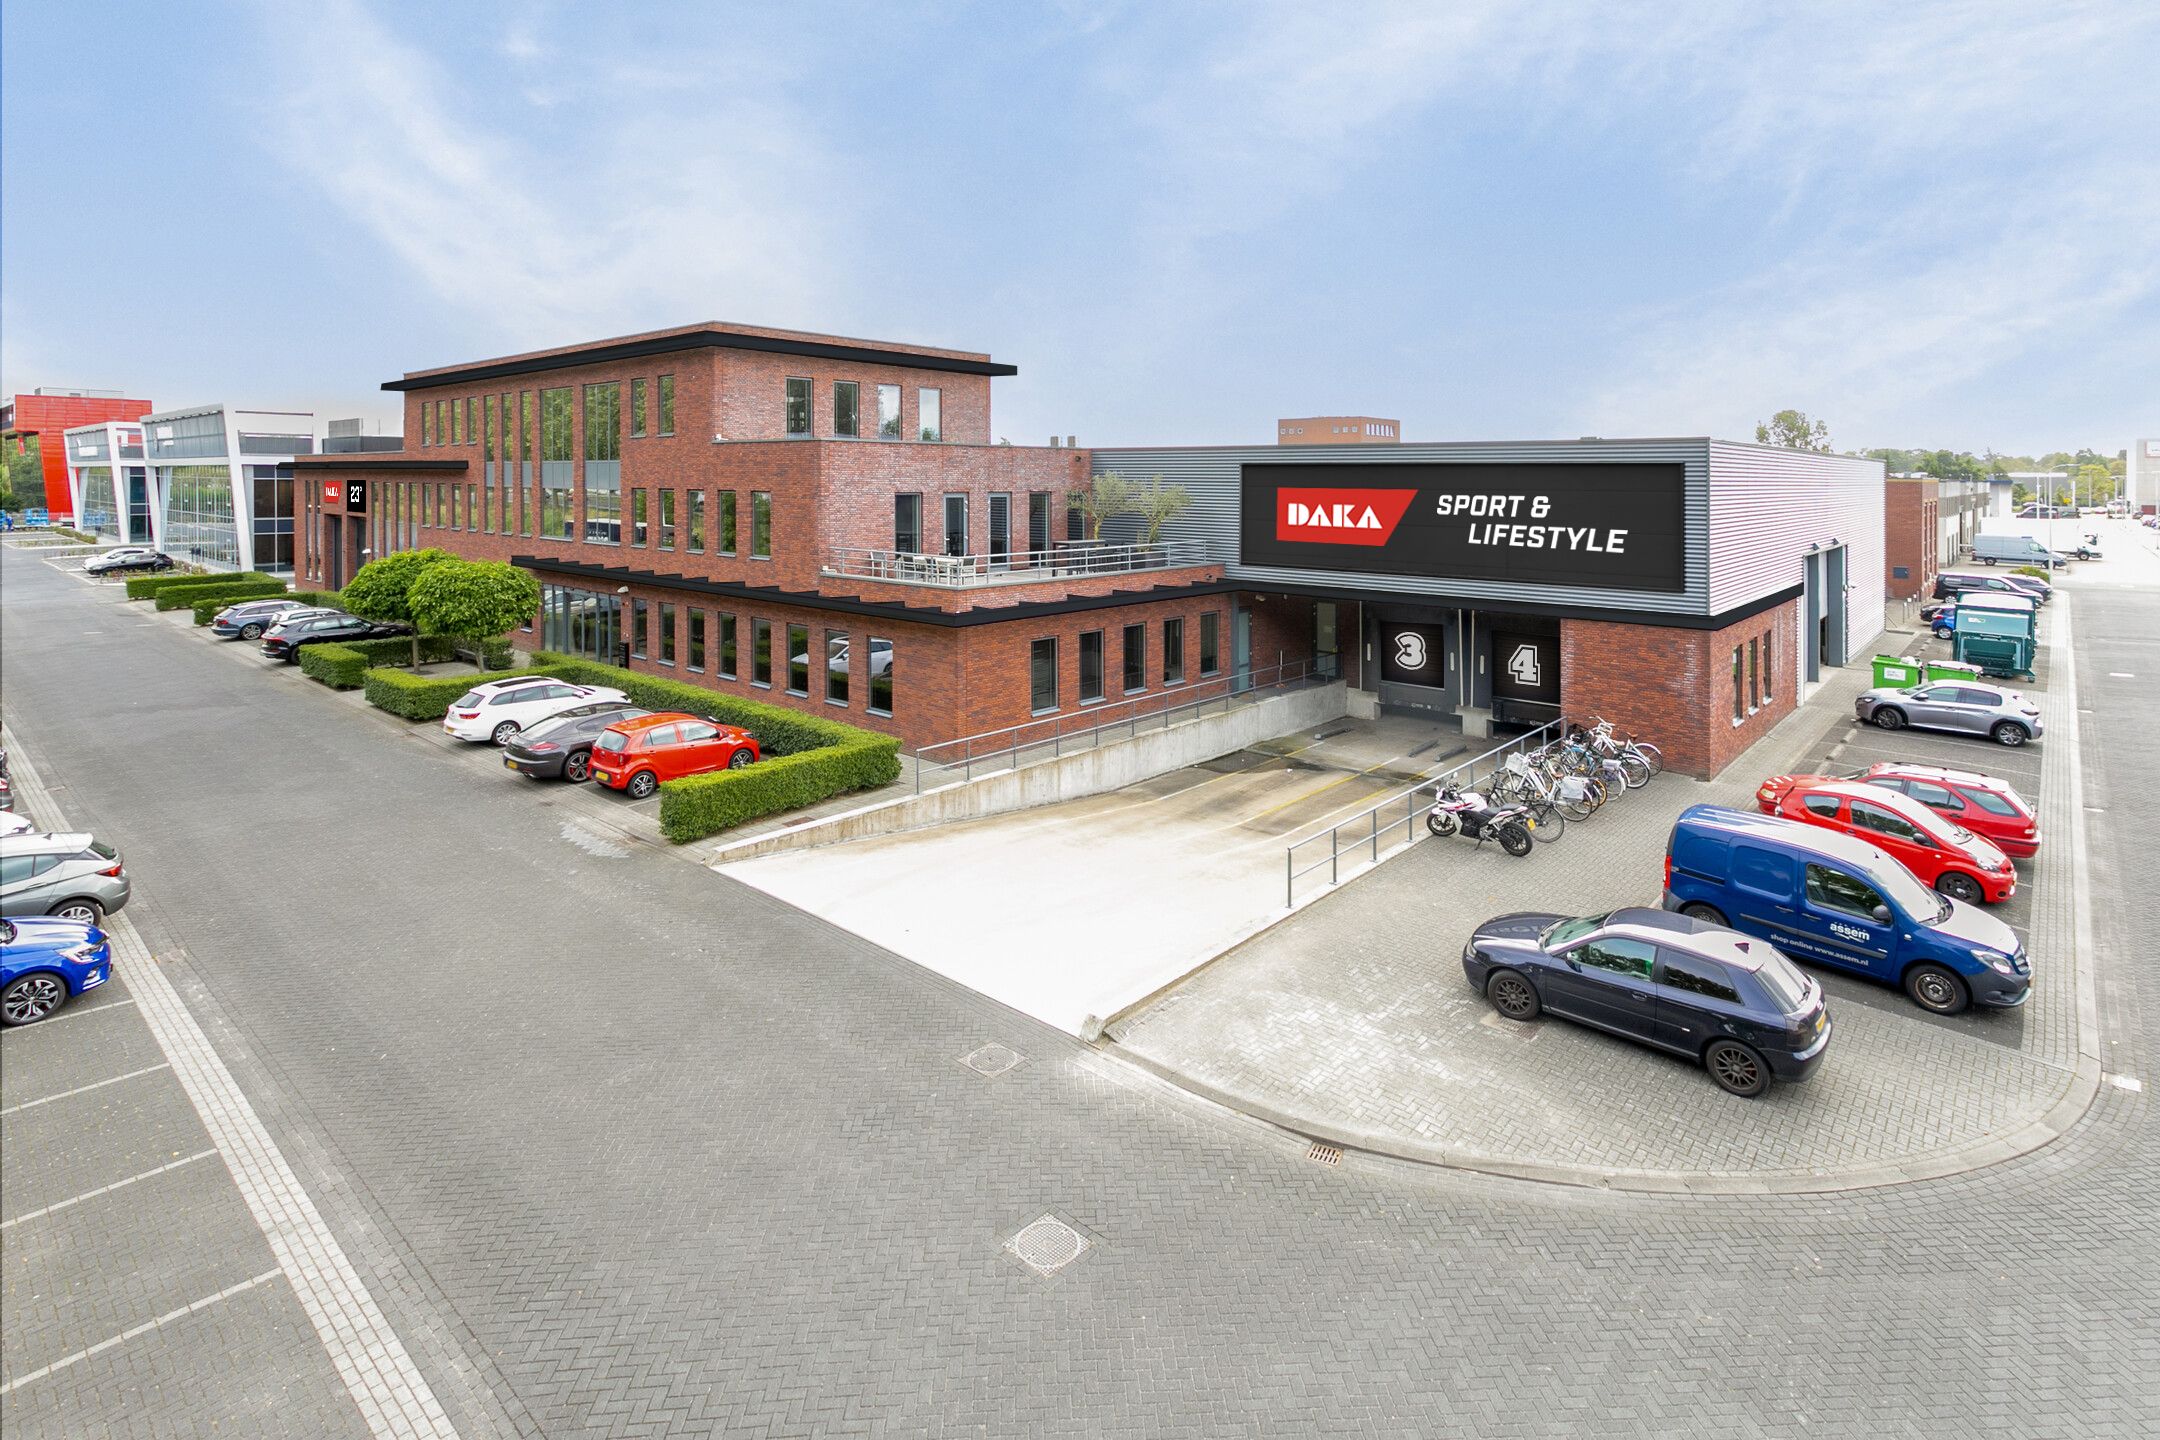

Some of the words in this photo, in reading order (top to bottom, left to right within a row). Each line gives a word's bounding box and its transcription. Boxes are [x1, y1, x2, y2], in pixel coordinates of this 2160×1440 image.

[1287, 503, 1382, 529] DAKA
[1436, 494, 1525, 518] SPORT
[1530, 495, 1551, 518] &
[1467, 523, 1629, 554] LIFESTYLE
[1394, 631, 1426, 670] 3
[1508, 644, 1541, 687] 4
[1829, 922, 1870, 941] assem
[1770, 933, 1789, 944] shop
[1789, 939, 1814, 950] online
[1814, 946, 1869, 966] www.assem.nl
